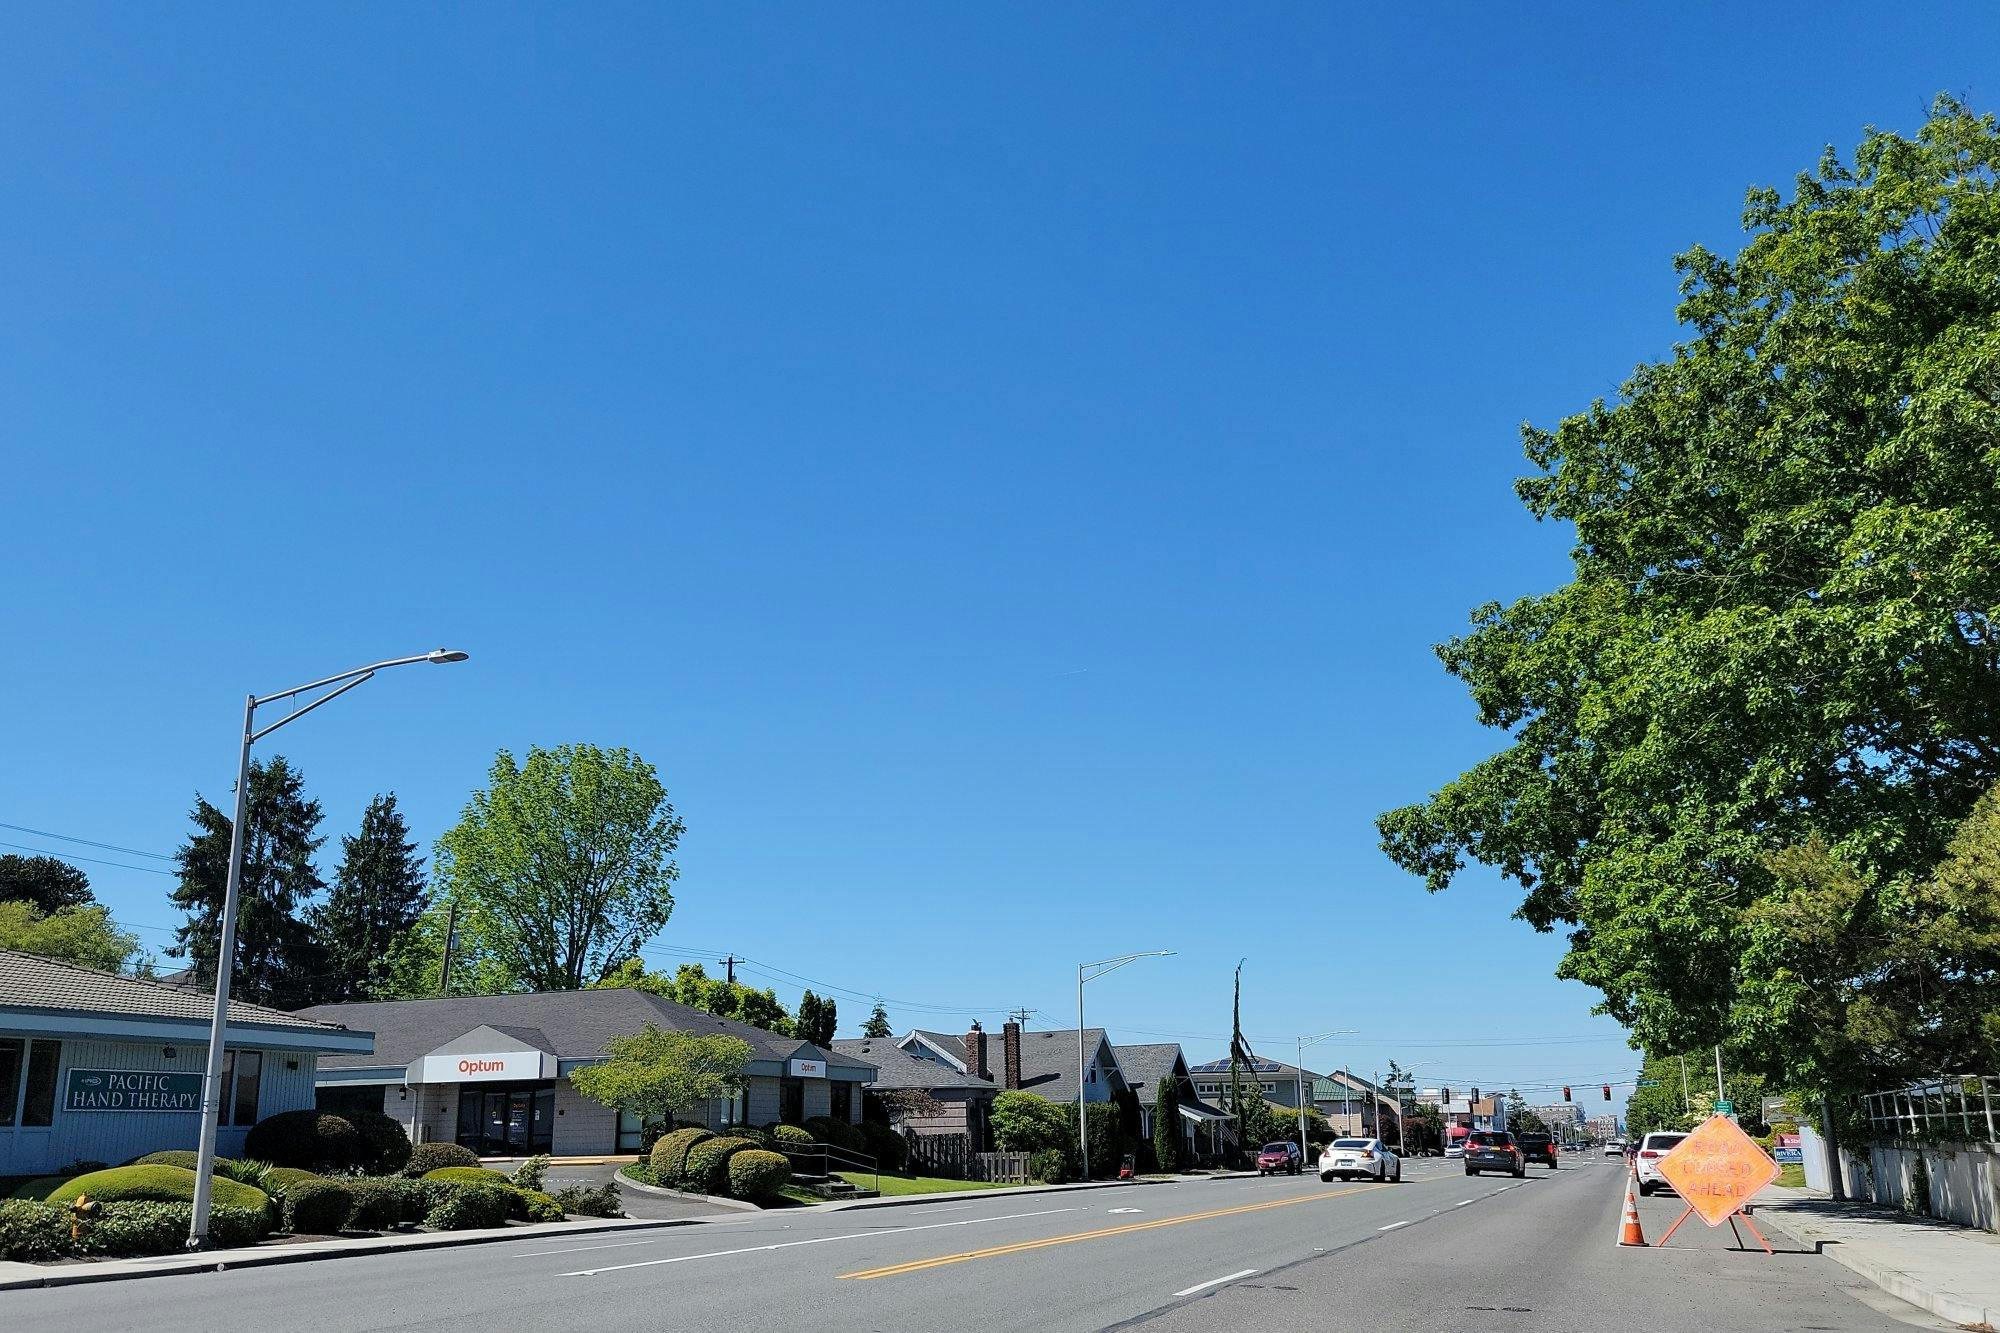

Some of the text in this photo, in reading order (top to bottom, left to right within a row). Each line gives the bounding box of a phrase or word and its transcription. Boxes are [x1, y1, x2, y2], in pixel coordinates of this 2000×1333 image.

[459, 1060, 504, 1075] Optum
[108, 1074, 170, 1091] PACIFIC
[73, 1091, 197, 1108] HAND THERAPY
[1682, 1160, 1751, 1178] CLOSED
[1686, 1182, 1747, 1197] AHEAD
